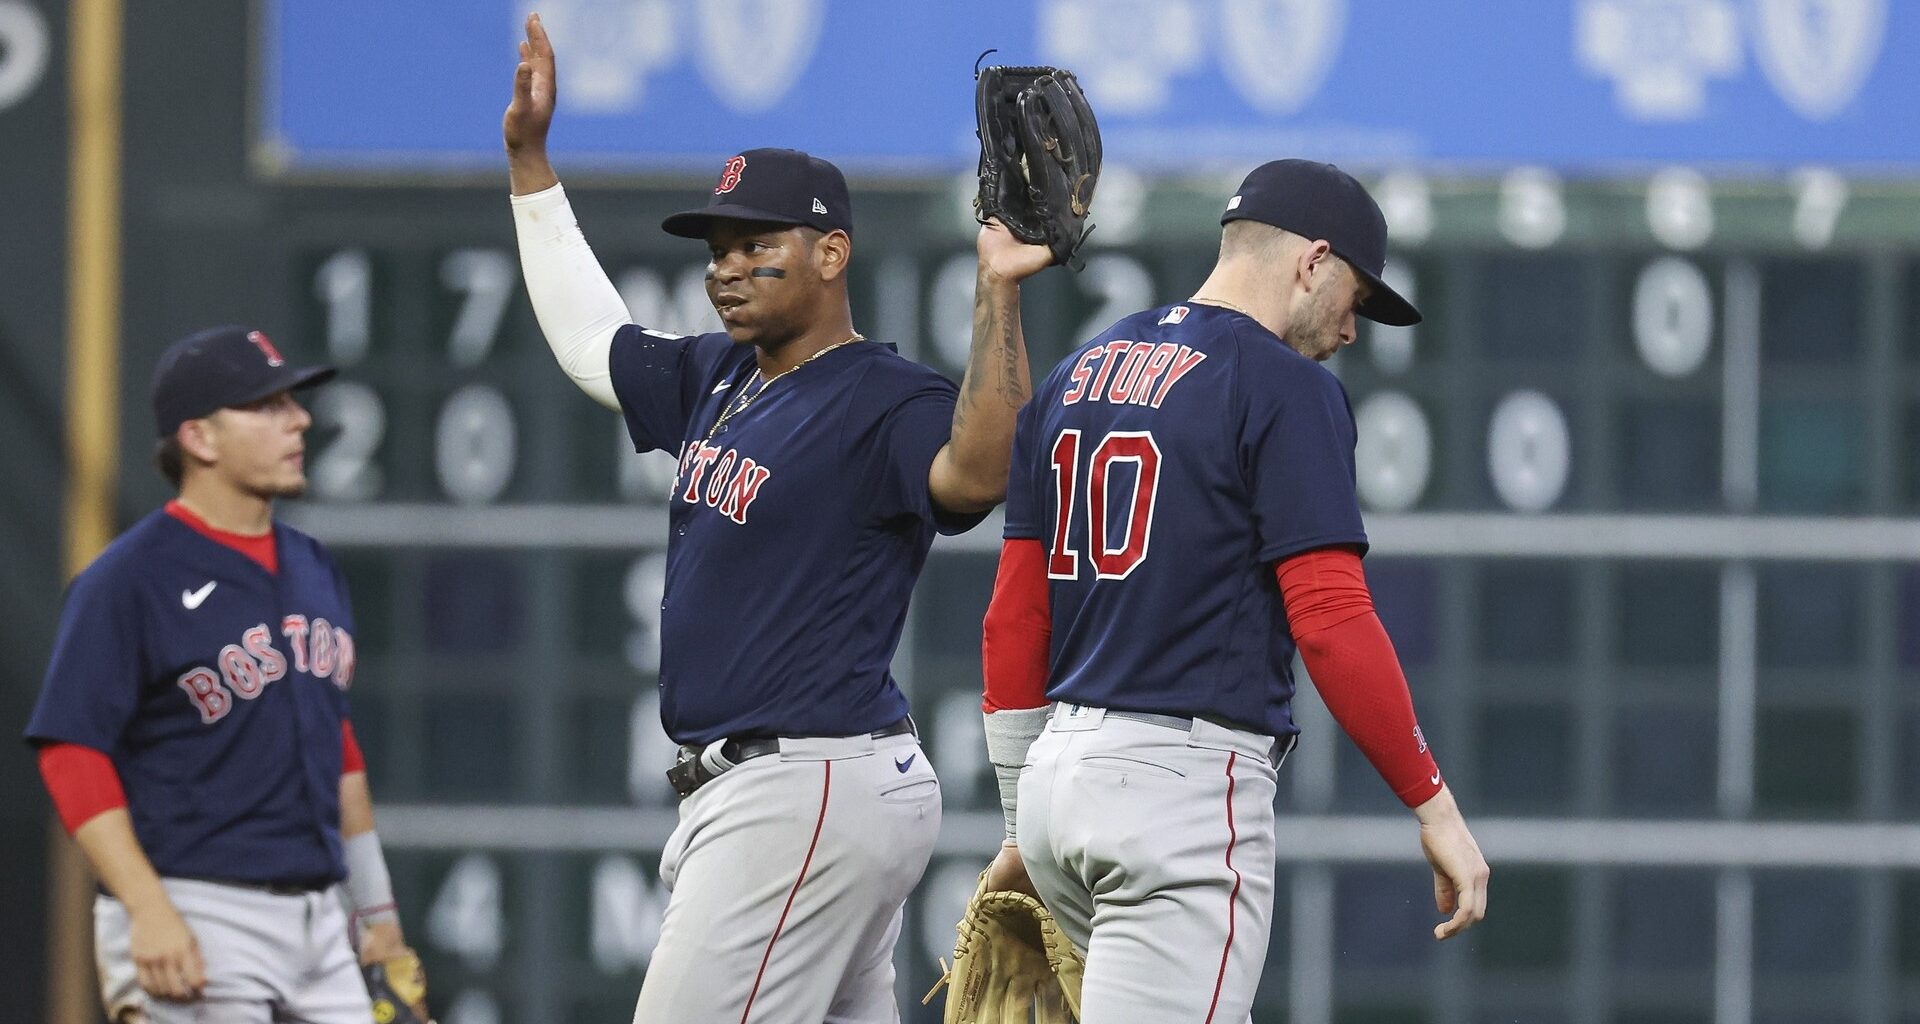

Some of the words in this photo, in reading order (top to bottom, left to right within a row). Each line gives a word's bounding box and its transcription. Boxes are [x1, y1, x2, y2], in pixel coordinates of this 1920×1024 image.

[715, 155, 747, 195] B
[1063, 340, 1207, 409] STORY
[1048, 429, 1163, 581] 10
[177, 614, 356, 724] BOSTON
